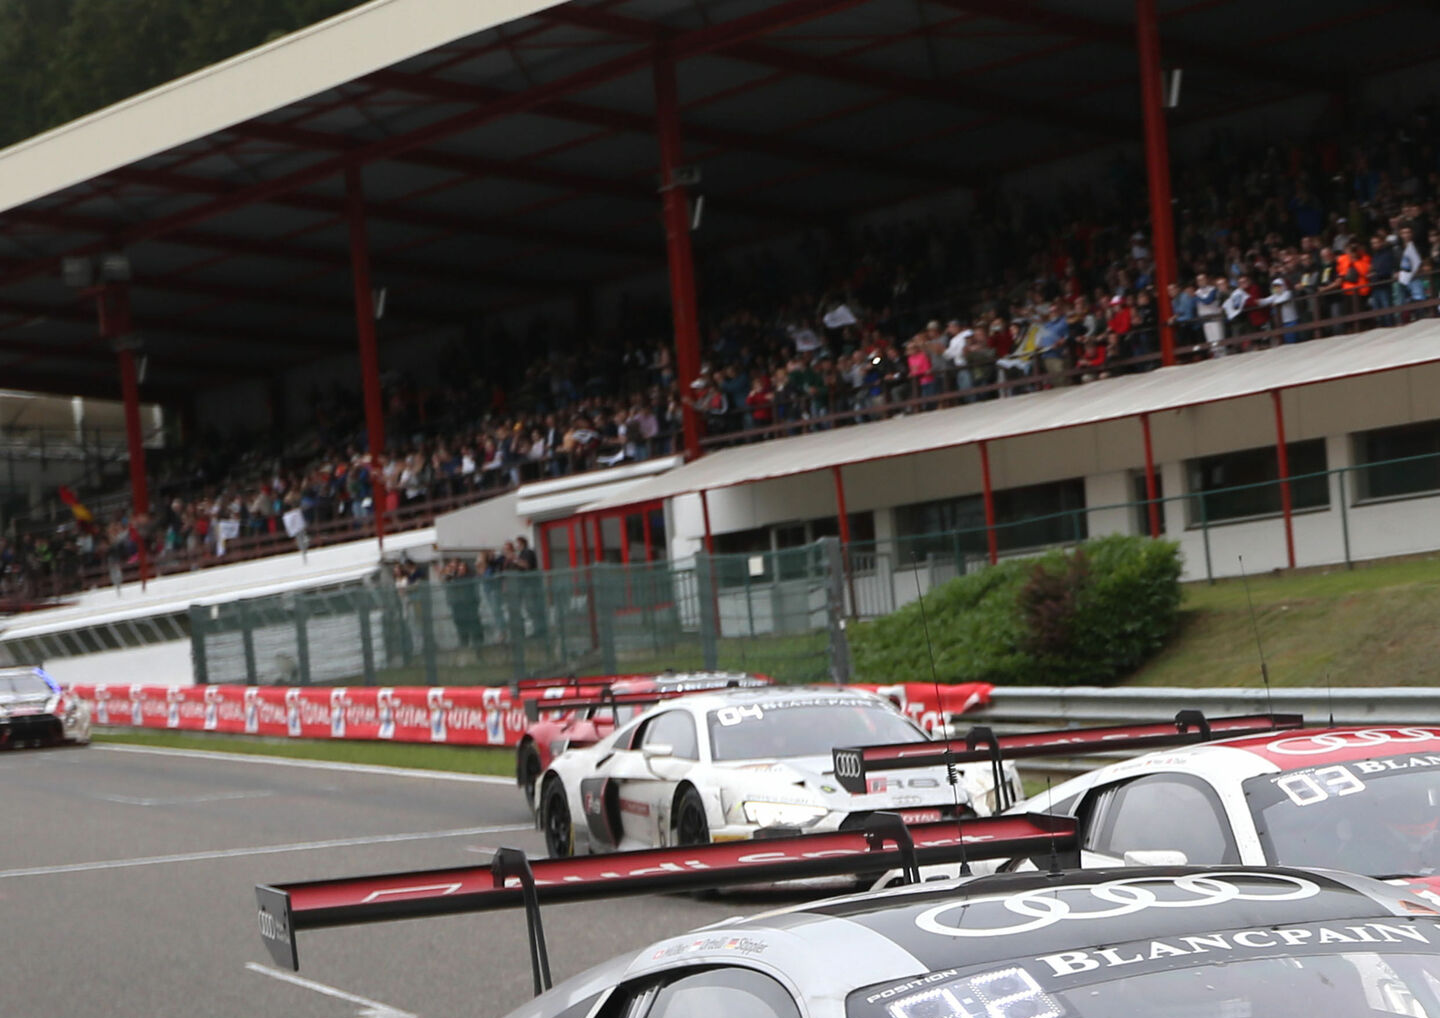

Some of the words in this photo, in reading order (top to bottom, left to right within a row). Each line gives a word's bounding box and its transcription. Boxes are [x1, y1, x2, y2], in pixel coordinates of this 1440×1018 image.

[717, 703, 764, 727] 04
[1277, 765, 1366, 806] 03
[902, 812, 942, 824] OTAL
[1036, 924, 1432, 977] BLANCPAIN
[867, 968, 958, 1004] POSITION
